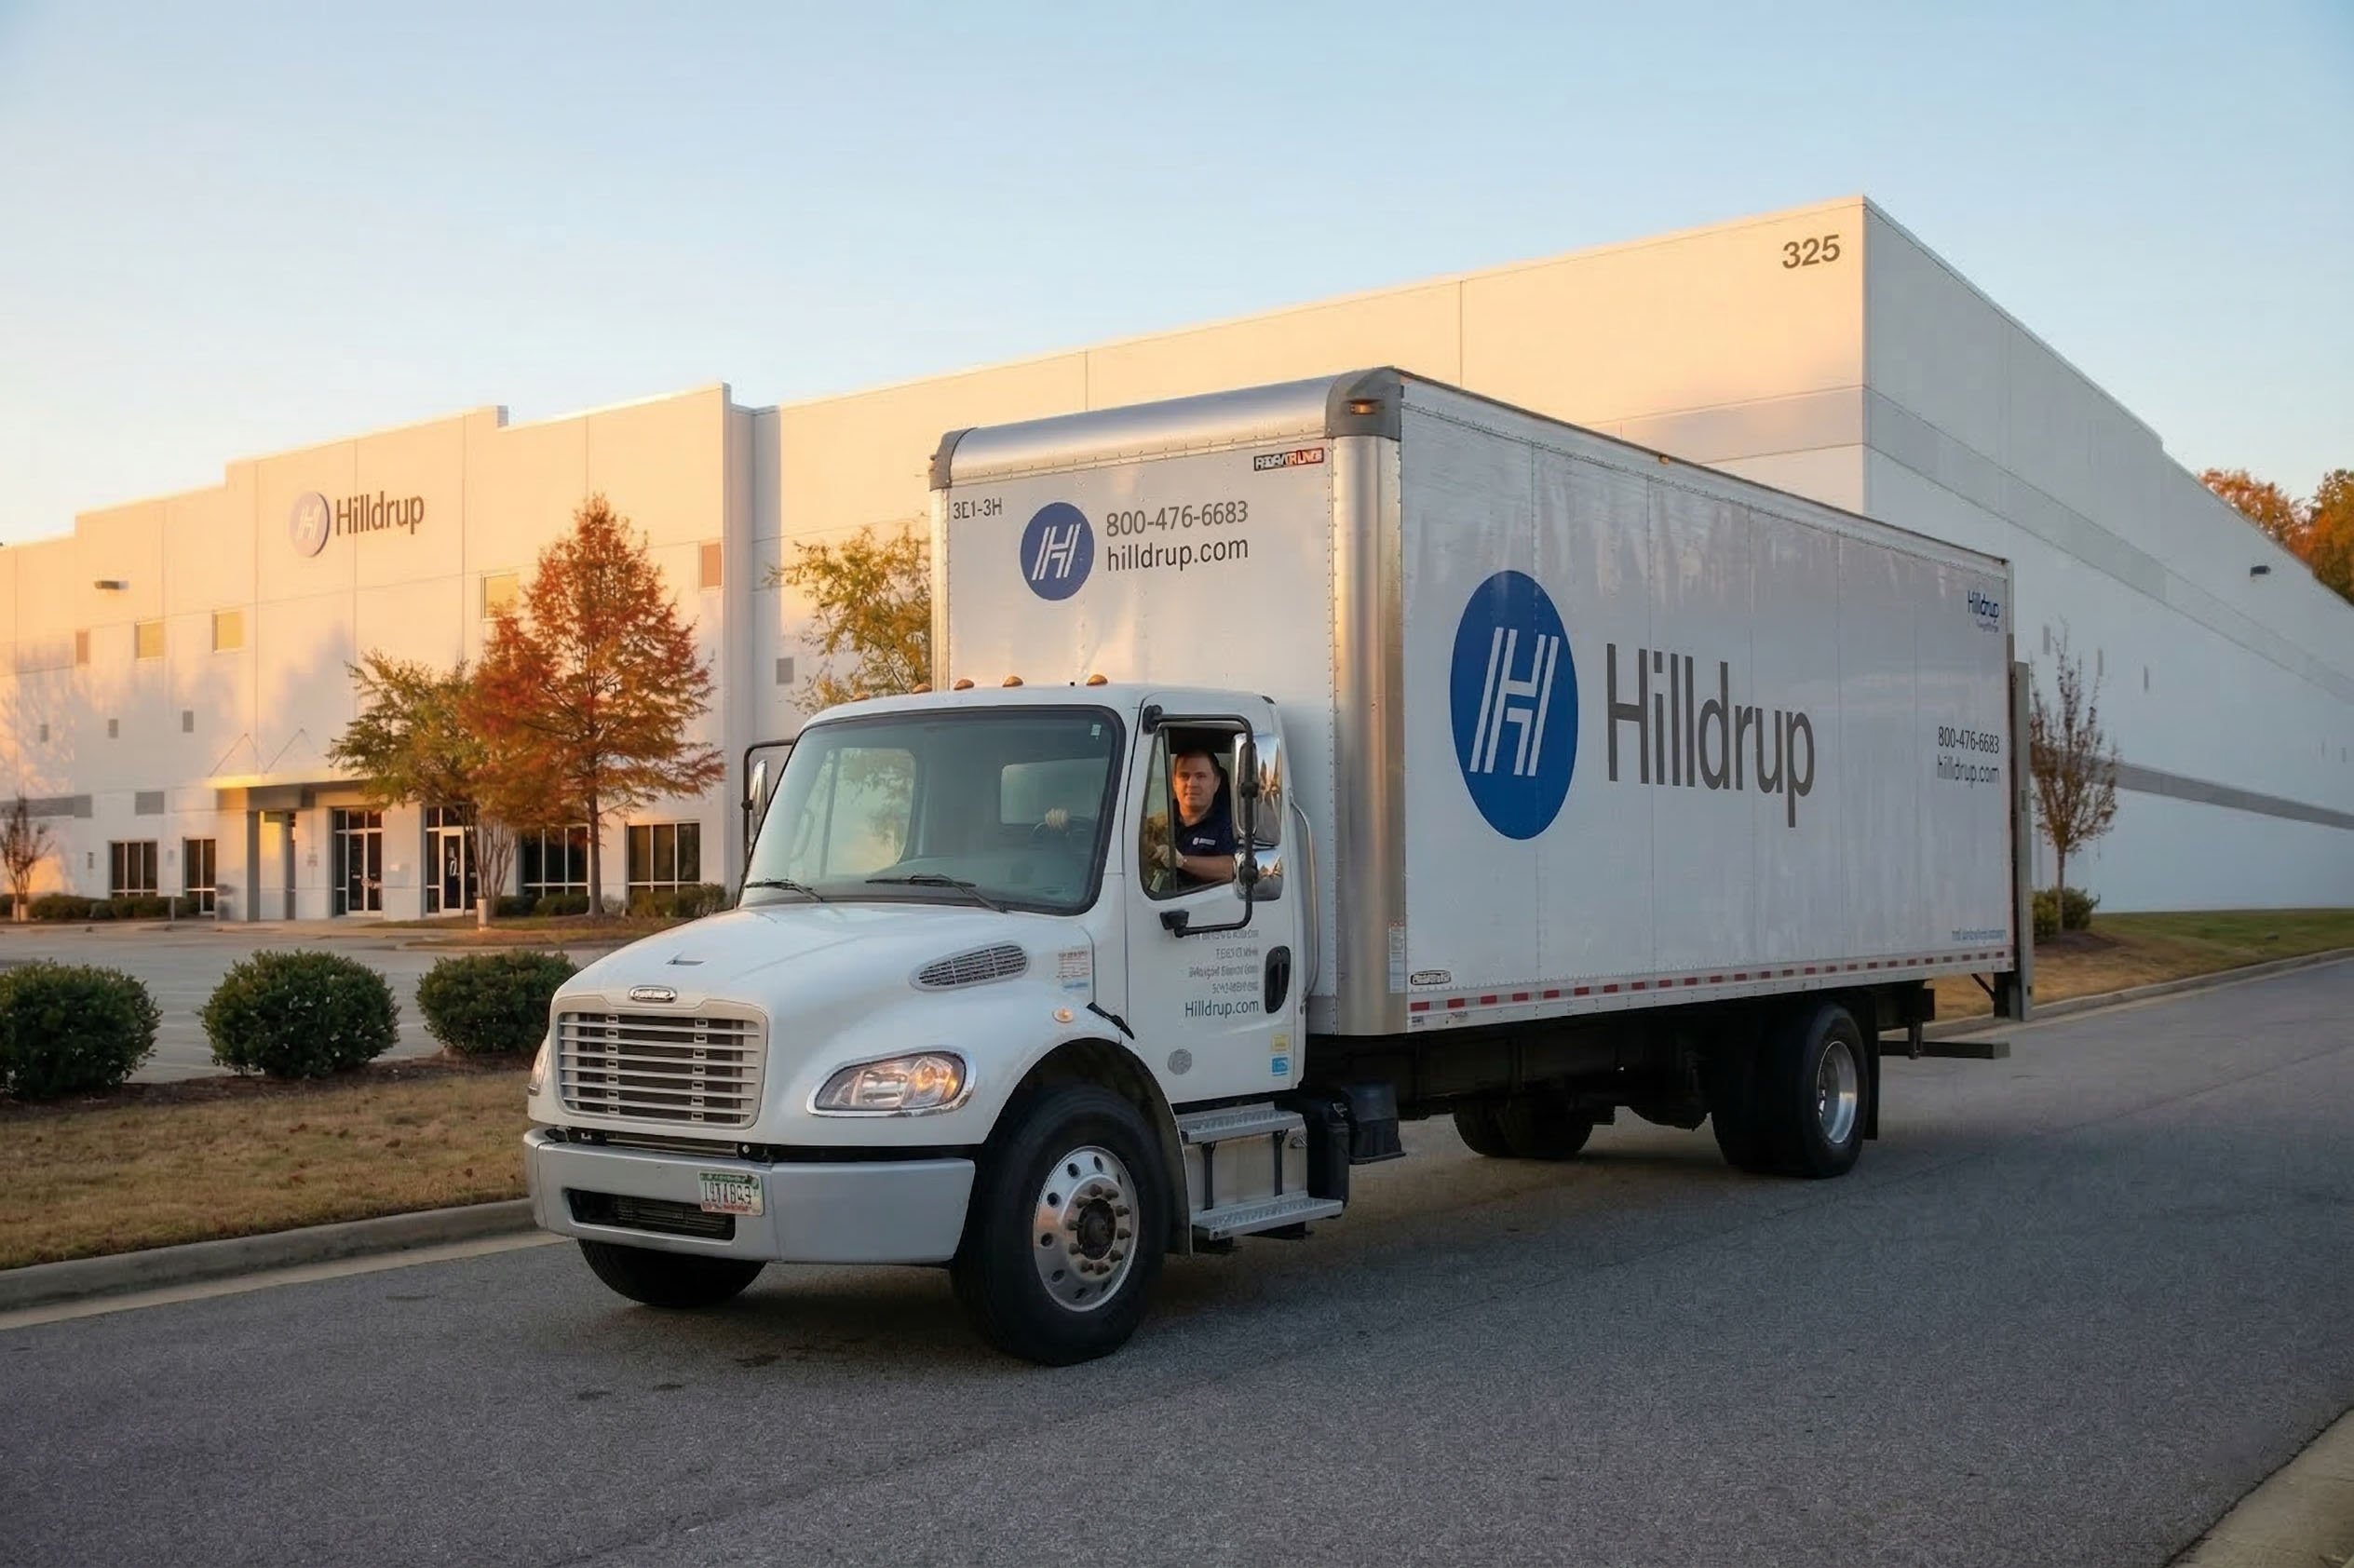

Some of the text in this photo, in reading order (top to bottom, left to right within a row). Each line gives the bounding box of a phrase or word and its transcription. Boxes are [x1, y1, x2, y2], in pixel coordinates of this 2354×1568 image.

[1782, 234, 1841, 269] 325
[336, 491, 425, 535] Hilldrup
[953, 497, 1003, 520] 3E1-3H
[1106, 500, 1249, 537] 800-476-6683
[1031, 522, 1081, 581] H
[1107, 538, 1249, 572] hilldrup.com
[1468, 626, 1815, 828] H Hilldrup
[1938, 725, 2000, 754] 800-476-6683
[1184, 999, 1259, 1019] Hilldrup.com
